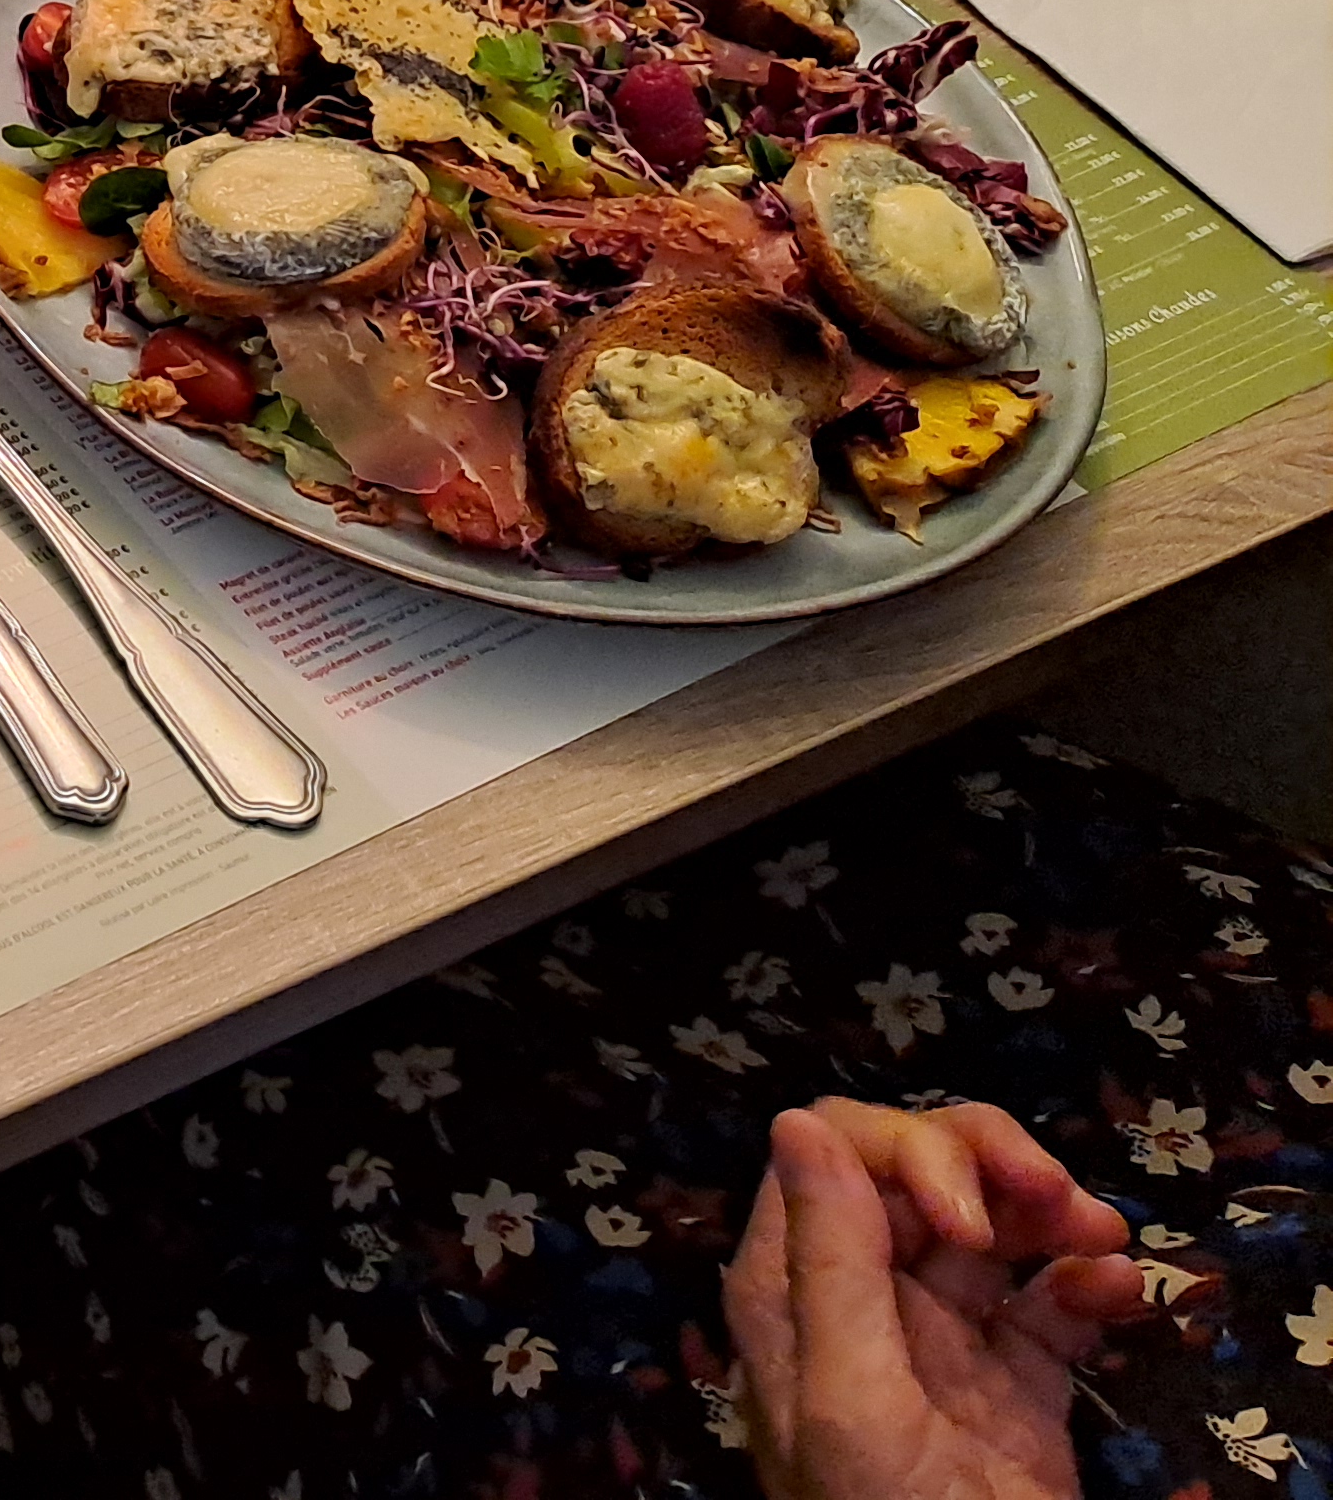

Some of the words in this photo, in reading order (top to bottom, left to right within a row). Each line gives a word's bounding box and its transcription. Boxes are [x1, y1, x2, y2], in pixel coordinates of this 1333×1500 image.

[1103, 317, 1152, 347] issons
[1147, 288, 1218, 325] Chaudes
[301, 649, 363, 682] Supplément
[323, 679, 374, 706] Garniture
[355, 689, 395, 711] Sauces
[393, 672, 432, 694] maison
